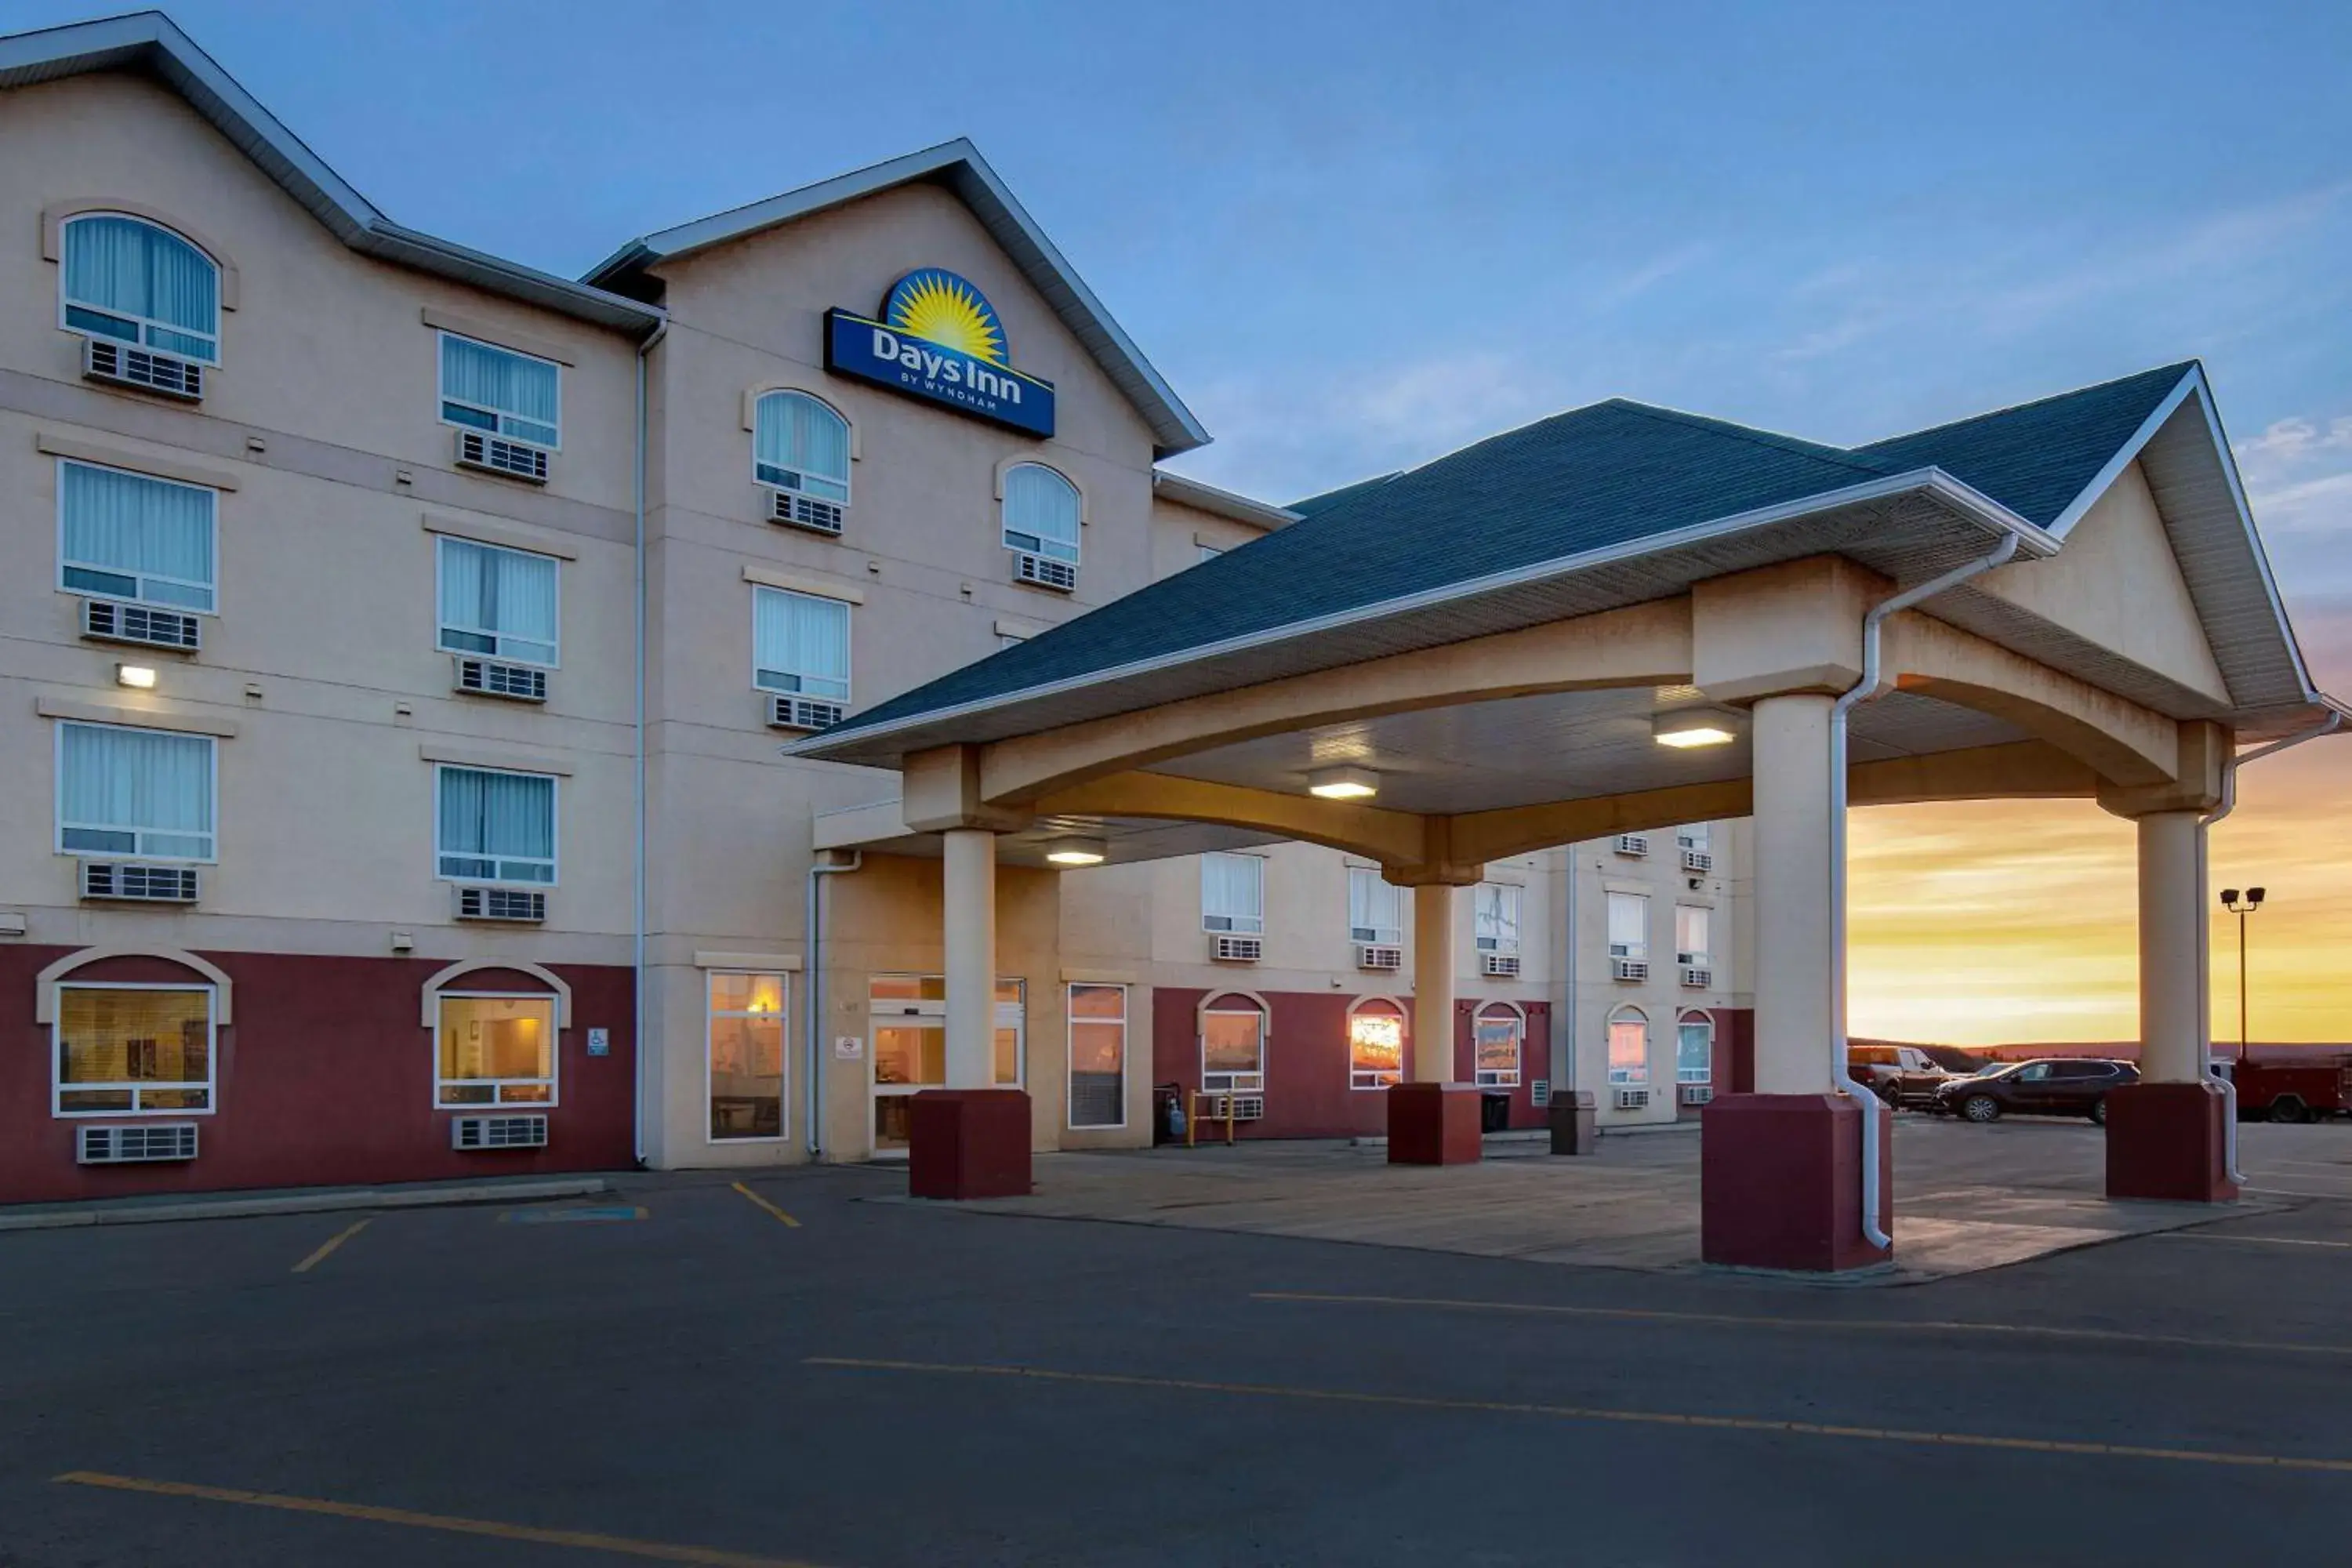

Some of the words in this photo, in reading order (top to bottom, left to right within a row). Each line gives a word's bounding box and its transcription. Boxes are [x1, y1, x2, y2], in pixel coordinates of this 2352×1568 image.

[873, 328, 961, 382] Days
[967, 361, 1022, 404] Inn
[902, 372, 917, 385] BY
[924, 379, 996, 410] WYNDHAM
